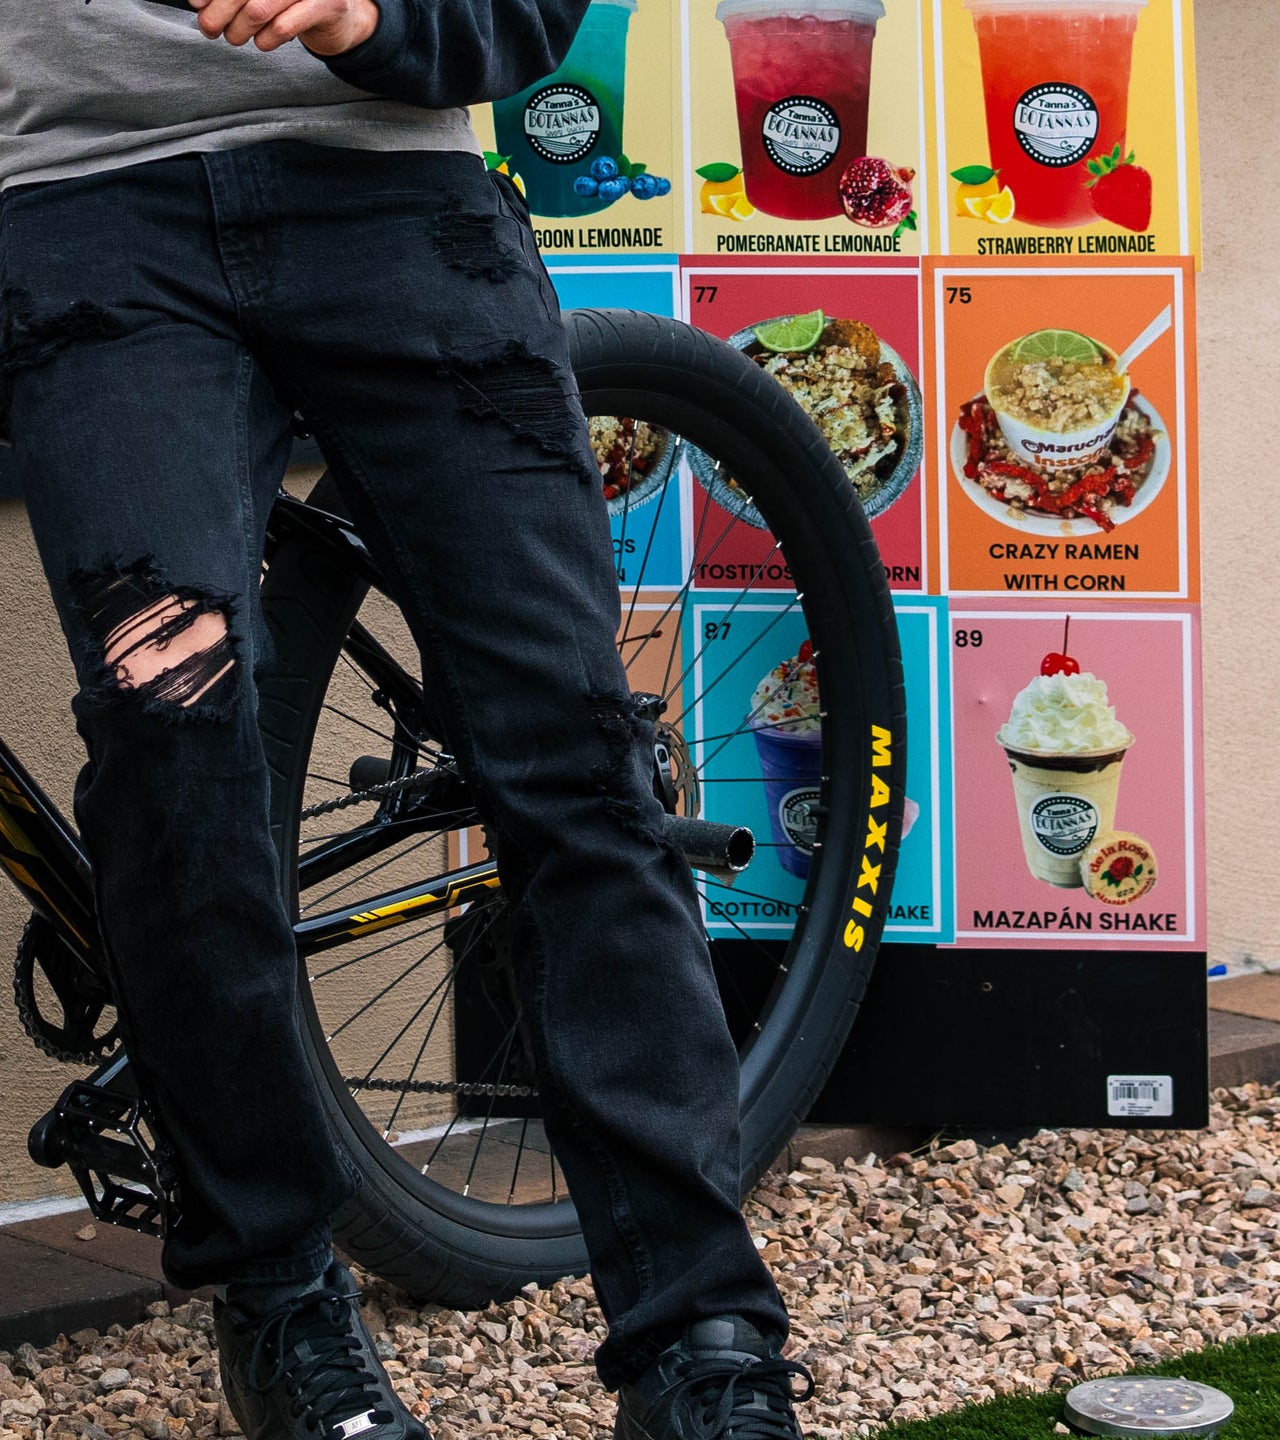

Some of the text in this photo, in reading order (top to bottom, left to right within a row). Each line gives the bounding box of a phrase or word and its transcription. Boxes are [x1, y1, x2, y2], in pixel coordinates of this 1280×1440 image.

[543, 97, 579, 109] Tanna's
[1038, 99, 1077, 109] Tanna's
[528, 107, 594, 128] BOTANNAS
[788, 109, 823, 123] Tanna's
[1019, 107, 1091, 129] BOTANNAS
[768, 115, 834, 142] BOTANNAS
[535, 227, 663, 248] GOON LEMONADE
[717, 233, 901, 253] POMEGRANATE LEMONADE
[977, 233, 1155, 257] STRAWBERRY LEMONADE
[694, 286, 718, 304] 77
[946, 287, 972, 304] 75
[989, 543, 1139, 561] CRAZY RAMEN
[699, 564, 920, 582] TOSTITOS ORN
[1005, 573, 1125, 591] WITH CORN
[705, 622, 731, 640] 87
[955, 629, 983, 648] 89
[843, 724, 891, 953] MAXXIS
[1101, 840, 1149, 861] la Rosa
[710, 901, 929, 920] COTTON HAKE
[973, 905, 1177, 932] MAZAPÁN SHAKE
